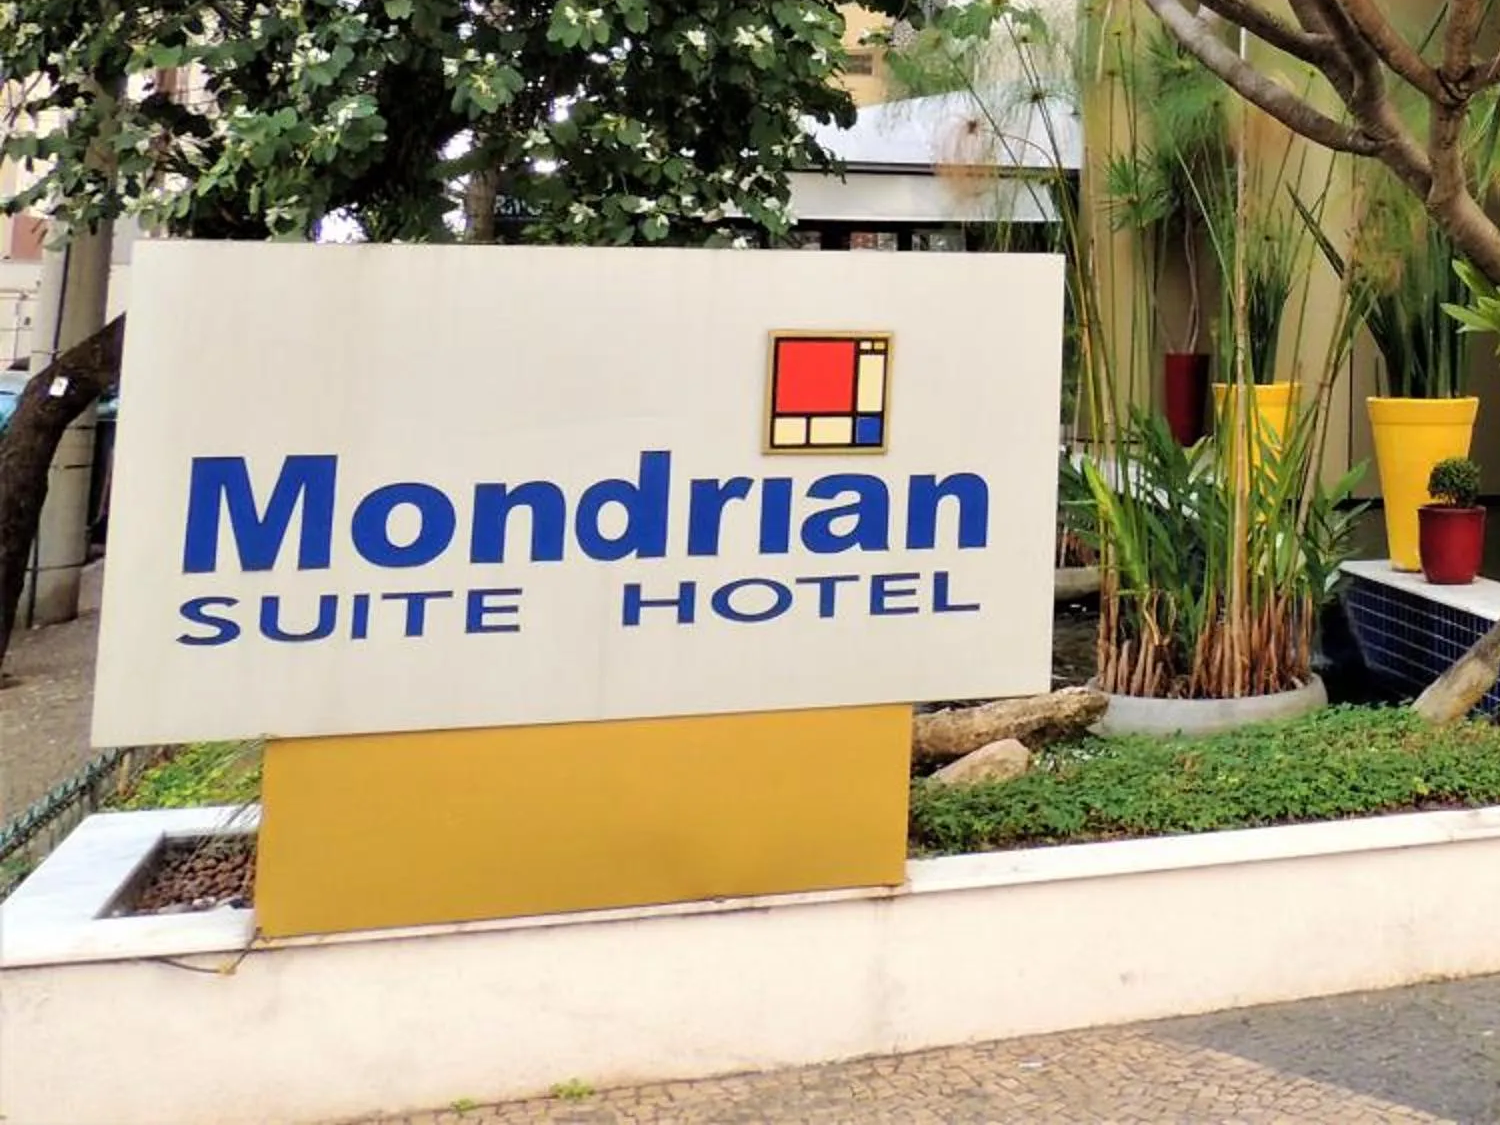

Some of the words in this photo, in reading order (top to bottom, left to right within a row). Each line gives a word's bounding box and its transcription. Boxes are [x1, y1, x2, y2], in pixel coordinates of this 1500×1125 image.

[182, 450, 990, 574] Mondrian
[176, 588, 523, 646] SUITE
[622, 571, 981, 627] HOTEL
